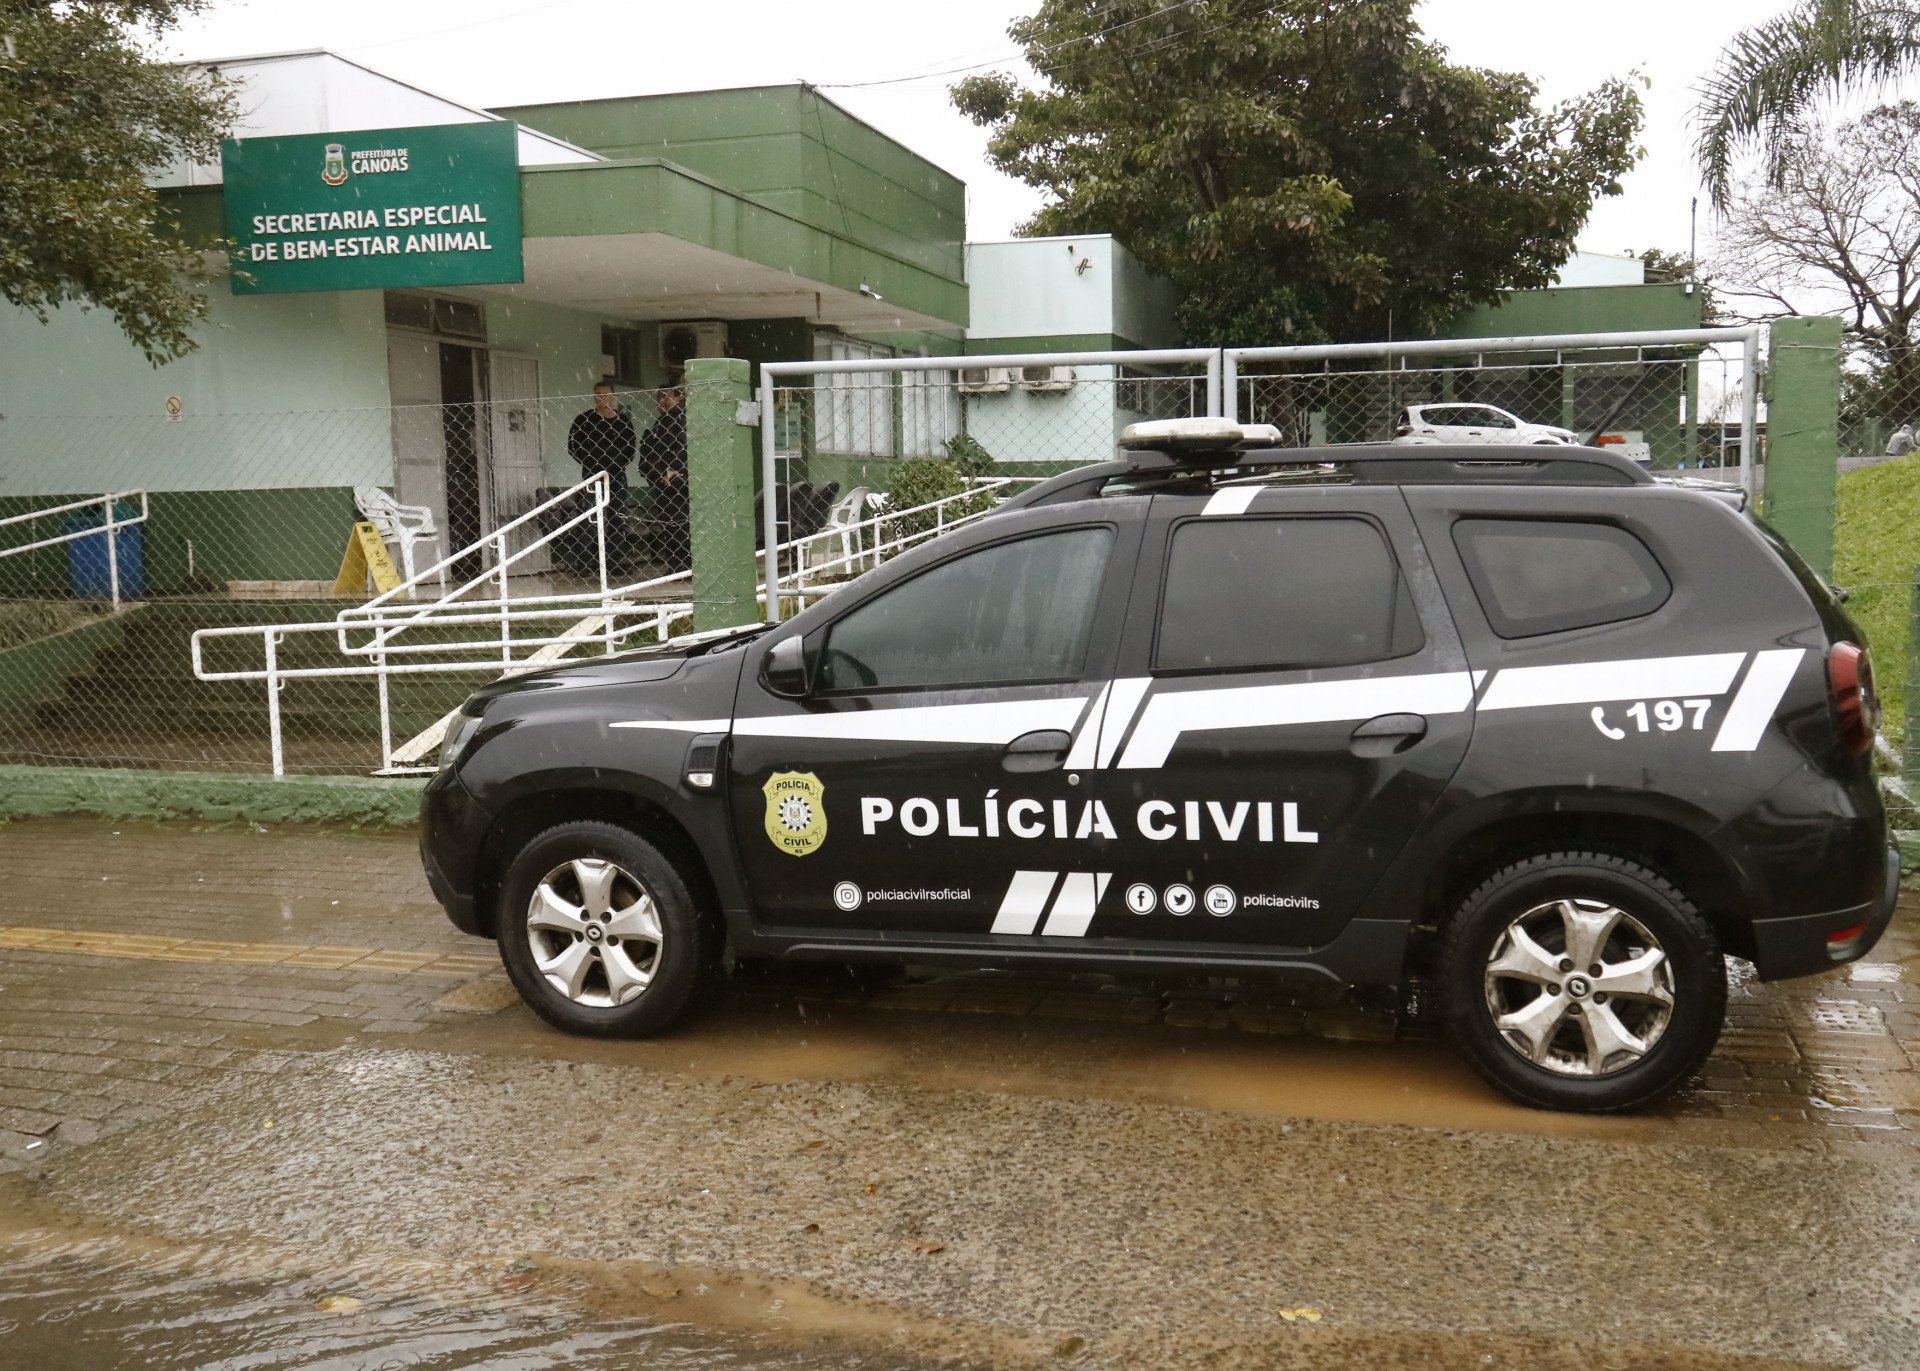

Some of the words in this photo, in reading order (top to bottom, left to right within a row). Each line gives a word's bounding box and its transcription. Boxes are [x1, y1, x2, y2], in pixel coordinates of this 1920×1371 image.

[351, 149, 396, 159] PREFEITURA
[397, 148, 408, 157] DE
[351, 157, 409, 174] CANOAS
[253, 210, 379, 234] SECRETARIA
[384, 203, 487, 227] ESPECIAL
[251, 242, 279, 262] DE
[283, 235, 400, 260] BEM-ESTAR
[405, 231, 492, 254] ANIMAL
[1626, 699, 1712, 732] 197
[860, 789, 1117, 839] POLÍCIA
[1137, 800, 1319, 843] CIVIL
[783, 837, 812, 847] CIVIL
[867, 888, 971, 903] policiacivilrsoficial
[1243, 894, 1320, 910] policiacivilrs
